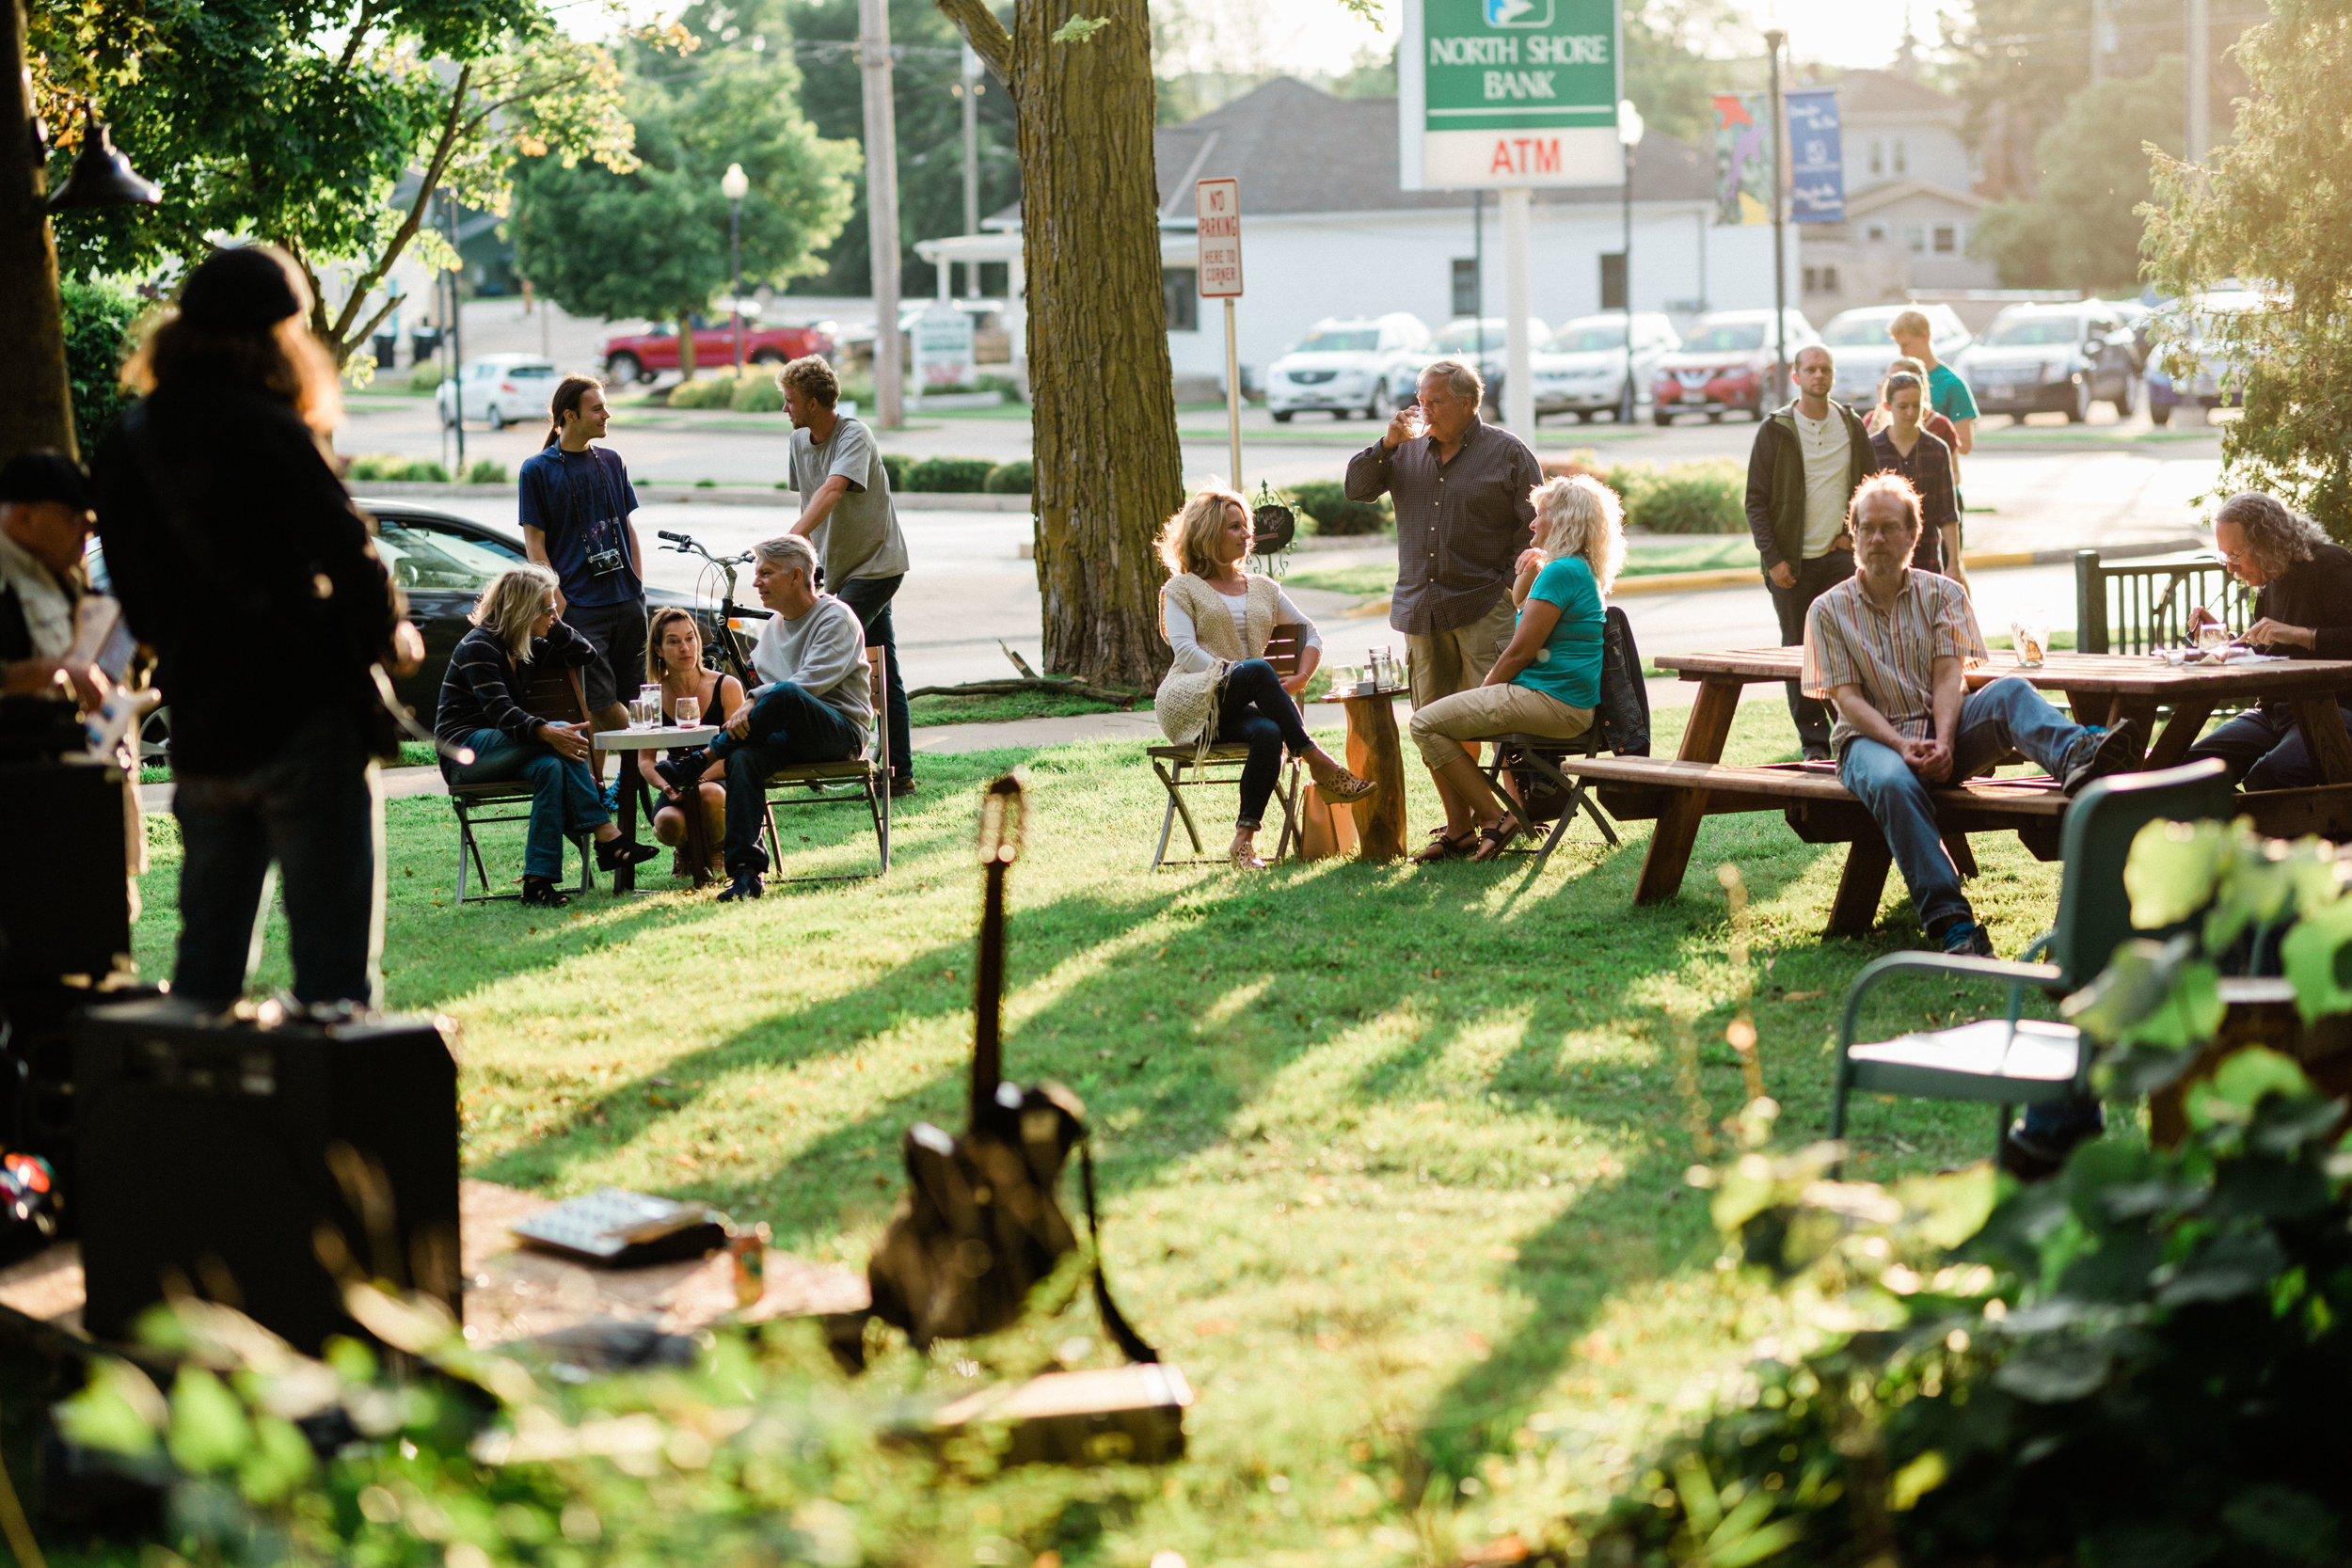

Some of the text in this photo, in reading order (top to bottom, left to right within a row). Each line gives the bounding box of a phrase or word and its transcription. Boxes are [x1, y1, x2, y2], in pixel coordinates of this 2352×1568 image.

[1430, 35, 1608, 65] NORTH SHORE
[1484, 71, 1556, 99] BANK
[1490, 138, 1561, 174] ATM
[1210, 190, 1225, 212] NO
[1200, 216, 1236, 237] PARKING
[1204, 249, 1235, 263] HERE TO
[1206, 268, 1235, 281] CORNER
